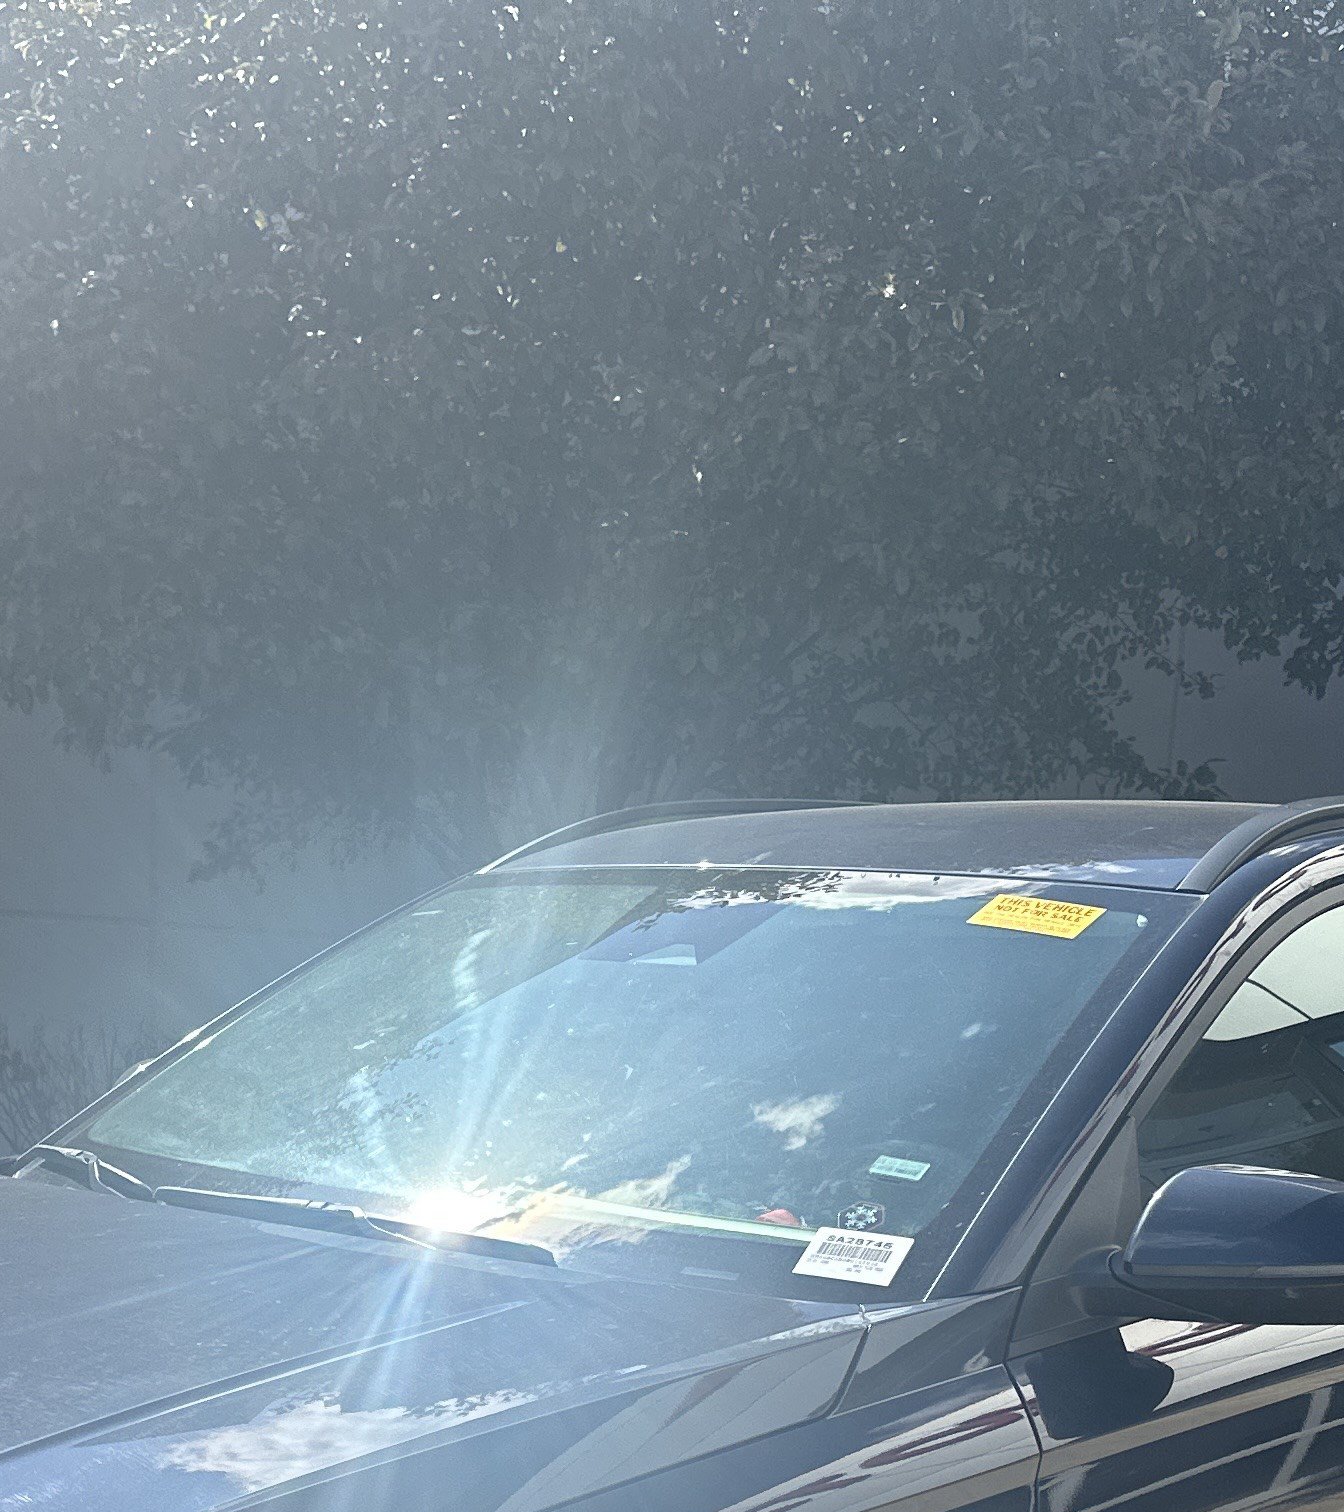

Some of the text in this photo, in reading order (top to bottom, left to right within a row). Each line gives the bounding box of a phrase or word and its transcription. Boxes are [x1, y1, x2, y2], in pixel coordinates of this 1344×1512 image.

[996, 904, 1019, 913] NOT
[1021, 908, 1048, 918] FOR
[1051, 912, 1083, 923] SALE
[1000, 897, 1096, 917] THIS VEHICLE
